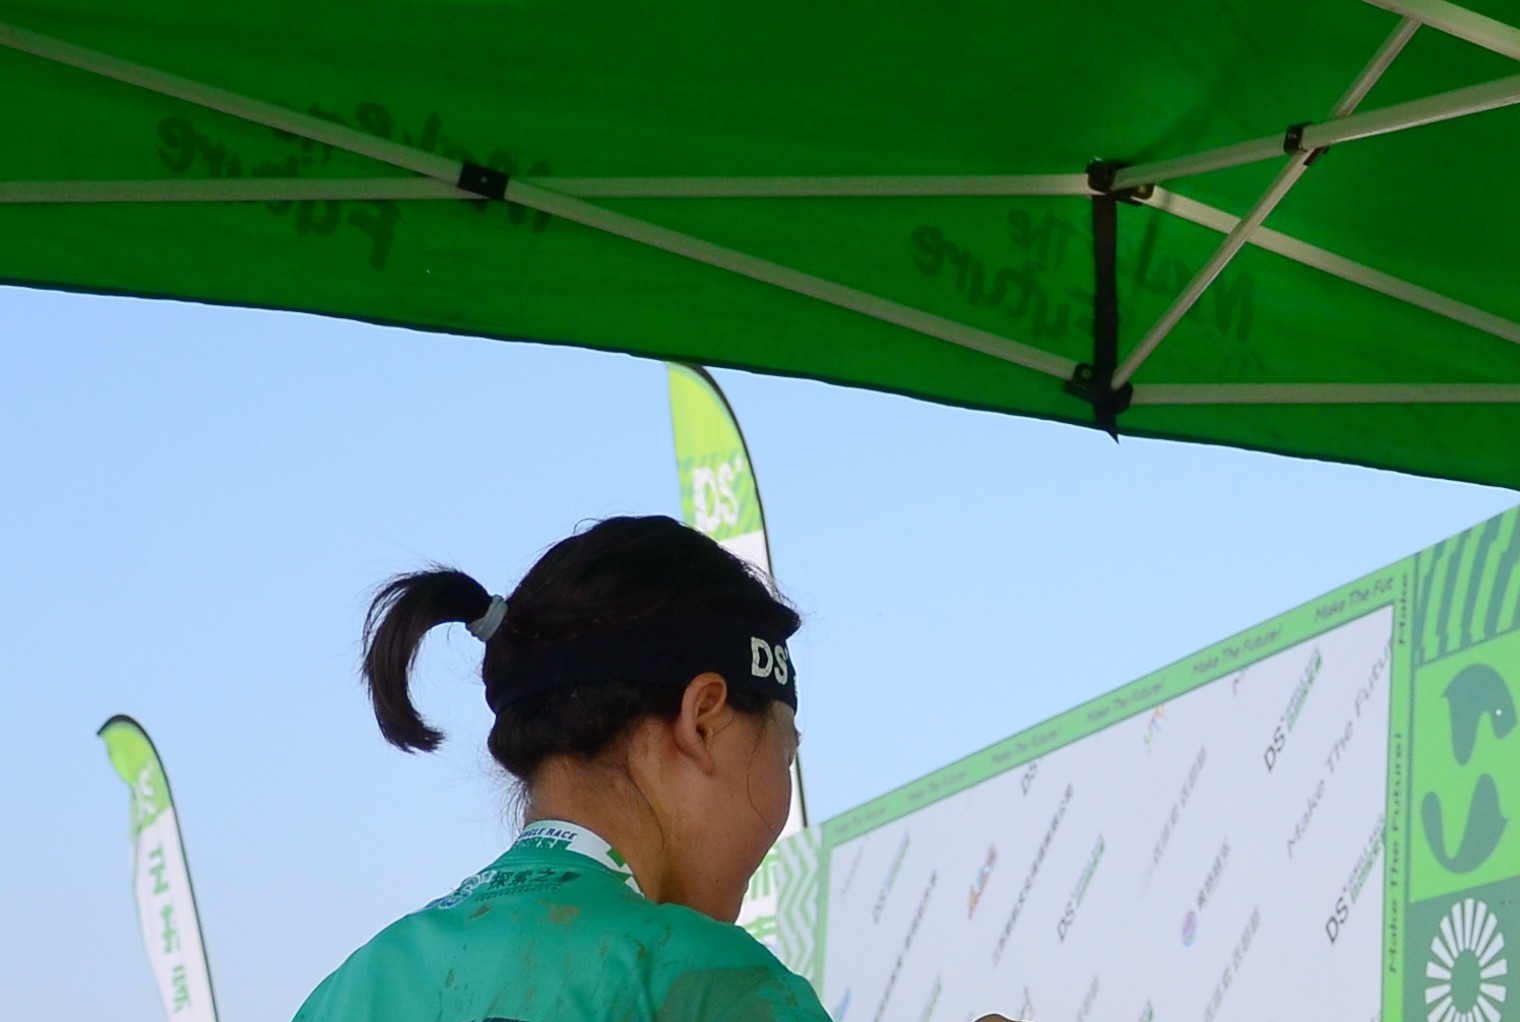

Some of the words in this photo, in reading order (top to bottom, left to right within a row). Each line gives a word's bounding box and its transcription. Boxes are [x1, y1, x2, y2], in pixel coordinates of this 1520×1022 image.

[692, 466, 738, 532] DS
[751, 636, 789, 686] DS
[1325, 895, 1350, 945] DS
